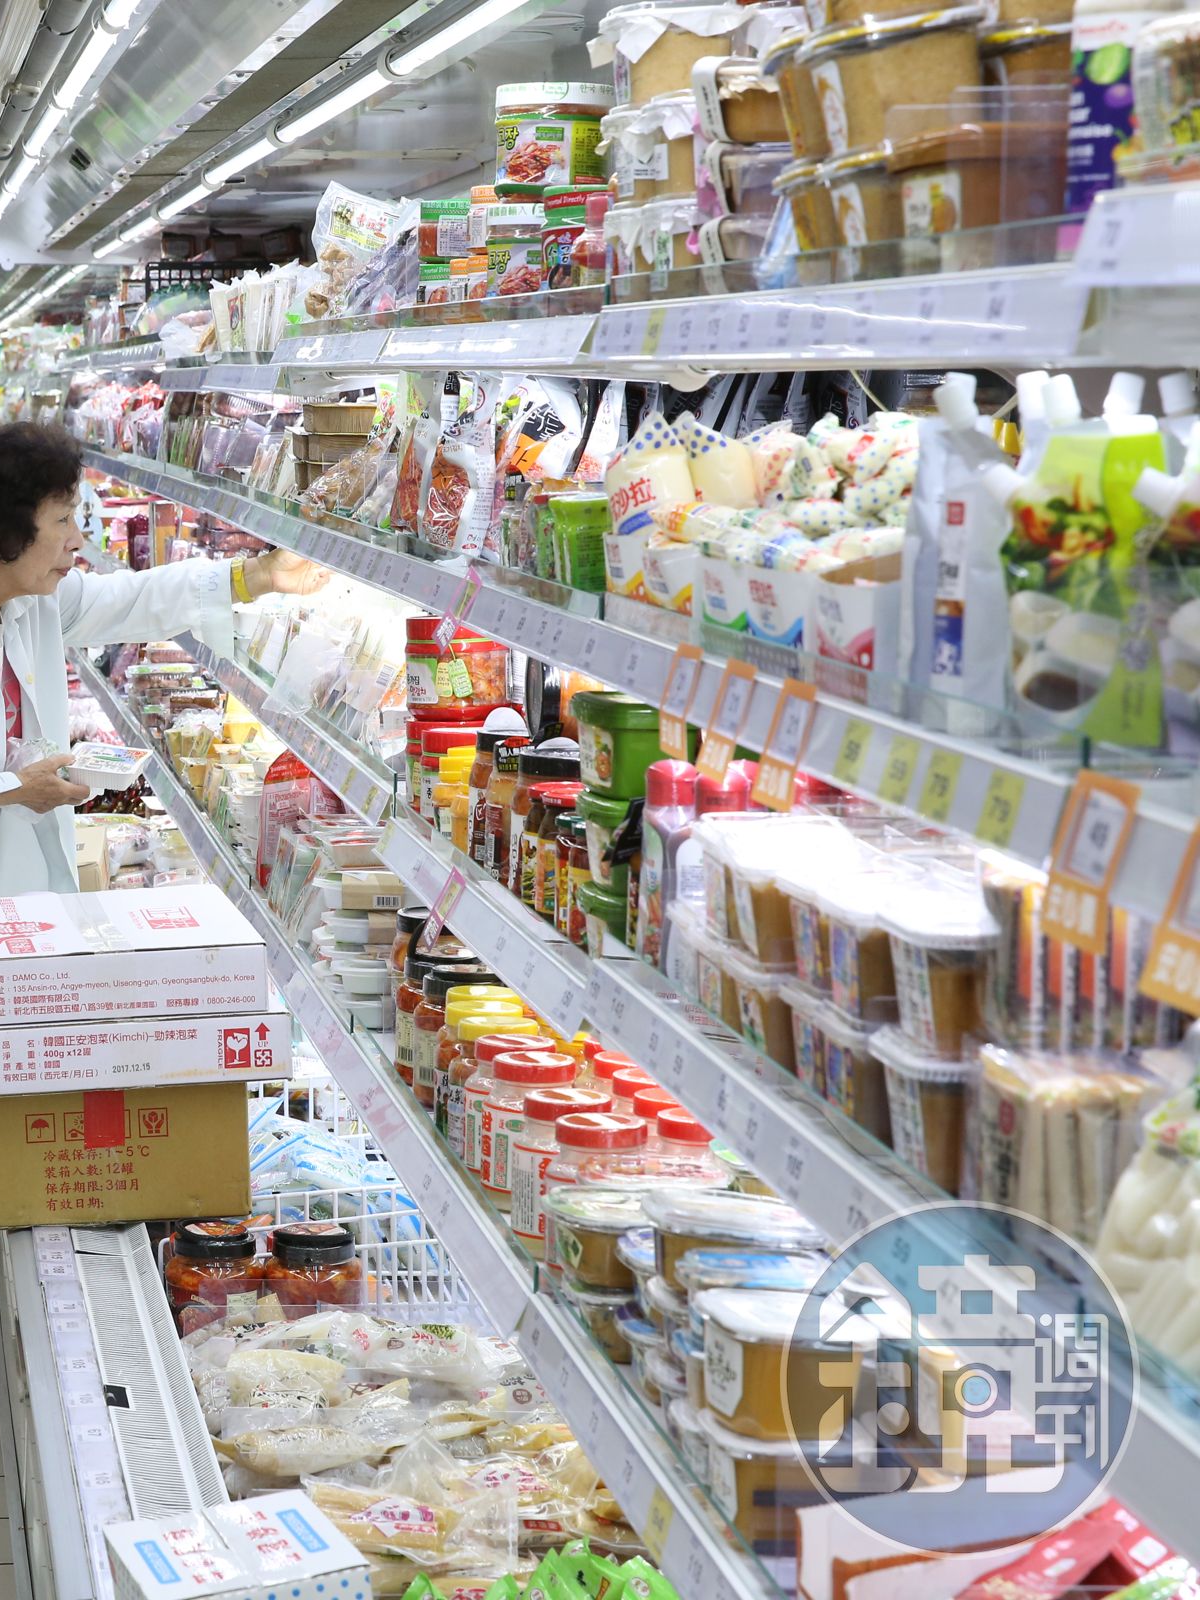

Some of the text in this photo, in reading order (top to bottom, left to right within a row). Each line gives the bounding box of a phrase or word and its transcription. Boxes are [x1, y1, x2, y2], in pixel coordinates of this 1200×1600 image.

[13, 985, 26, 993] 135
[161, 975, 232, 986] Gyeongsangbuk-do,
[233, 974, 255, 982] Korea
[207, 995, 255, 1005] 0800-246-000
[43, 1050, 64, 1058] 400g
[44, 1060, 60, 1069] 韓國
[112, 1062, 151, 1073] 2017.12.15
[106, 1161, 134, 1176] 12罐
[105, 1178, 140, 1192] 3個月
